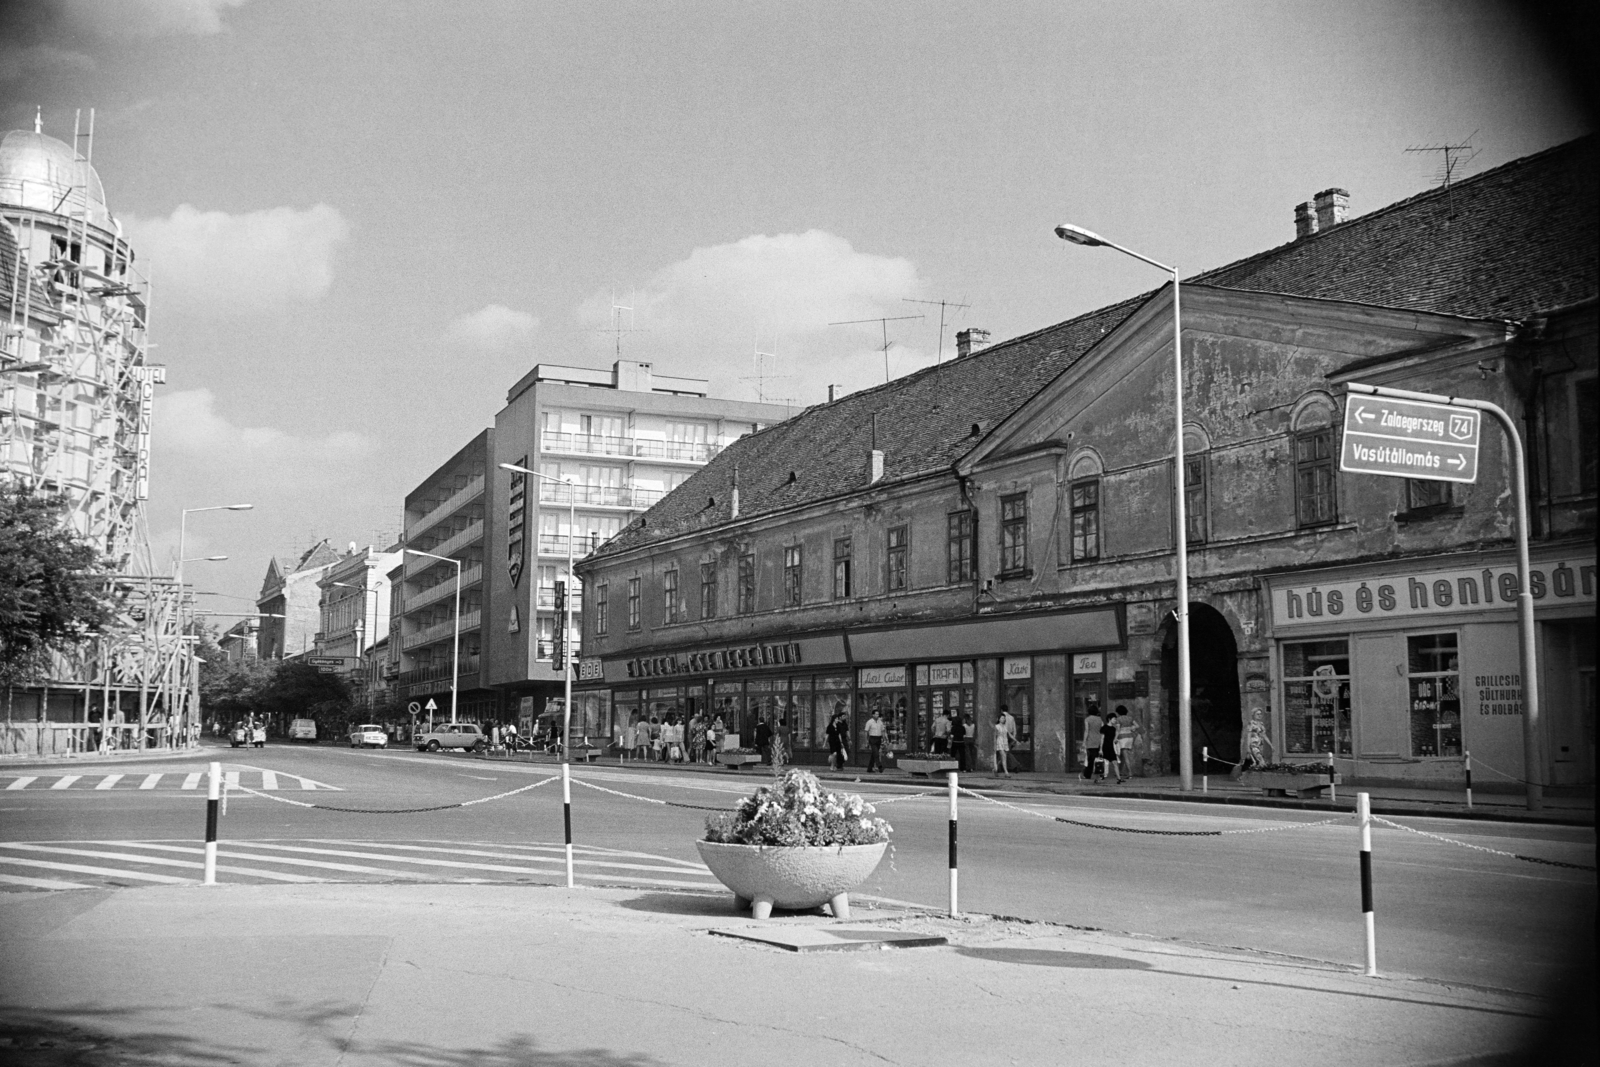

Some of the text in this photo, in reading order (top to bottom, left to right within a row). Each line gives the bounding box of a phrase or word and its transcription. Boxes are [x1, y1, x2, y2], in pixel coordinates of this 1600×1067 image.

[1381, 409, 1468, 436] Zalaegerszeg 74
[1353, 443, 1440, 468] Vasútállomás
[1287, 587, 1344, 618] hús
[1356, 581, 1396, 613] és
[1079, 657, 1097, 670] Tea
[931, 667, 960, 681] TRAFIK
[1480, 702, 1490, 716] ÉS
